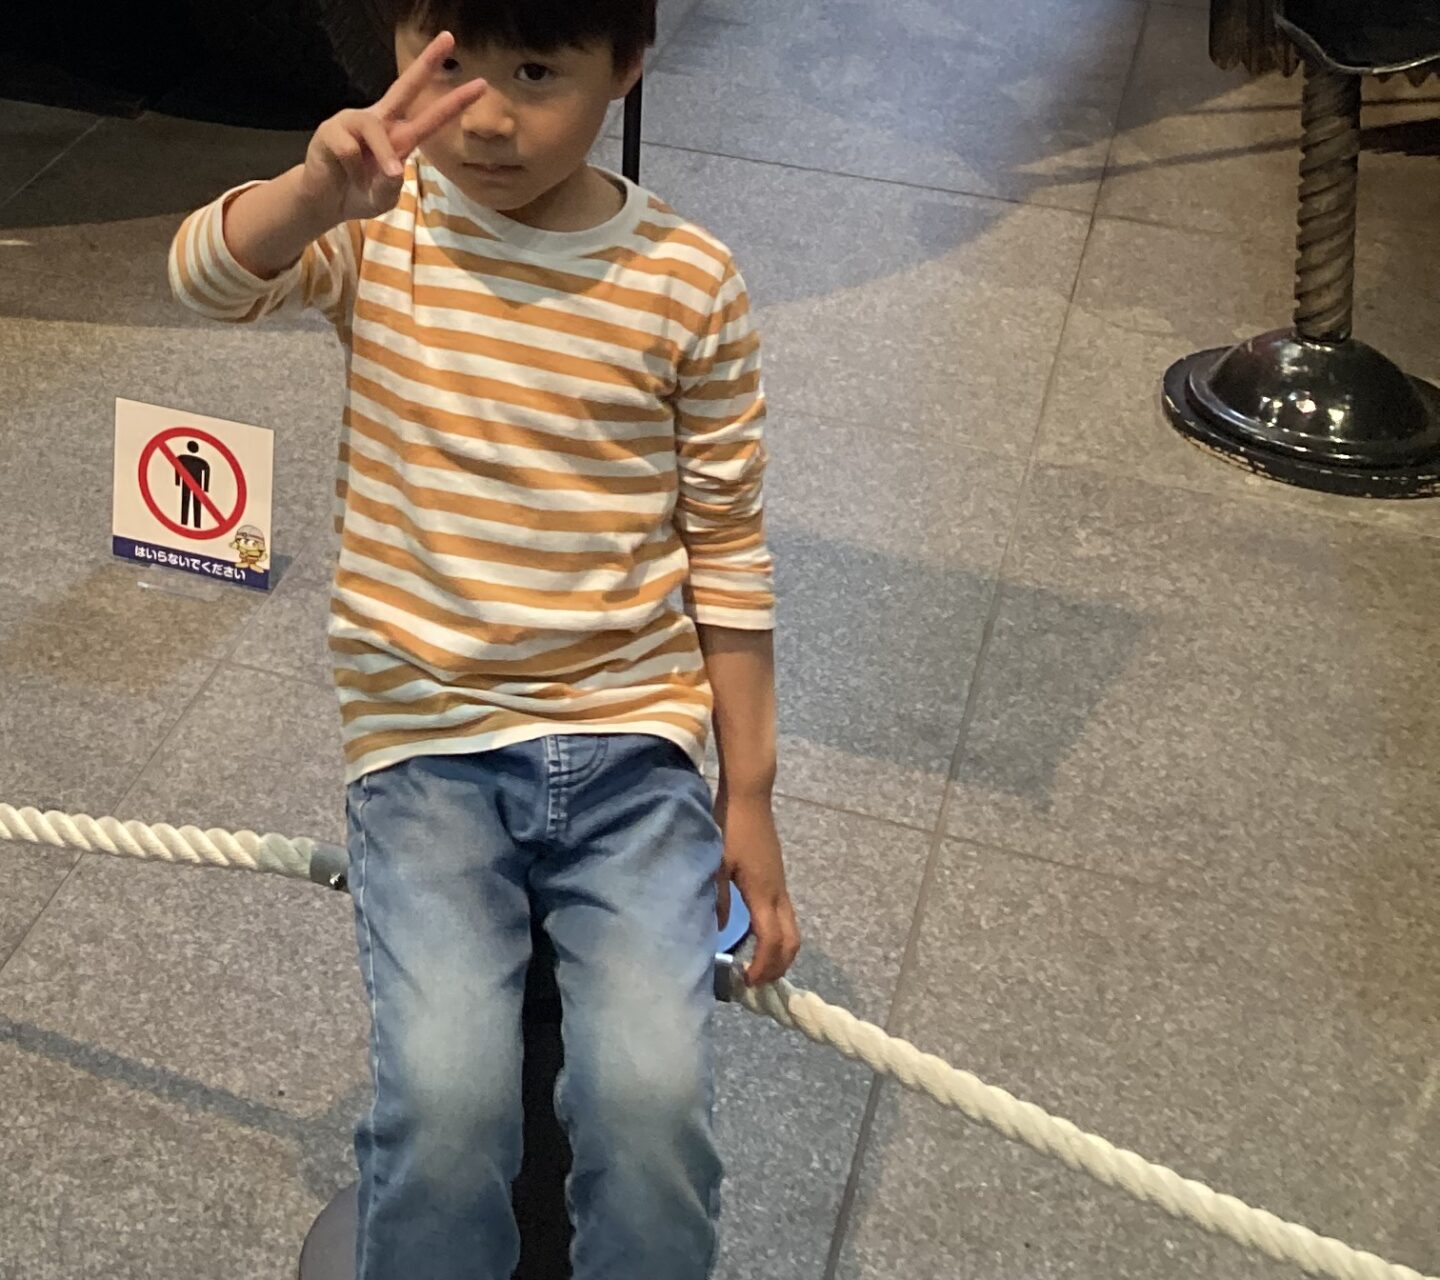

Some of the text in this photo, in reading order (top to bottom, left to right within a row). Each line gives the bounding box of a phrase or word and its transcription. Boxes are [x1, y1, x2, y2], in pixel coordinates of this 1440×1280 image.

[134, 545, 247, 580] はいらないでください
